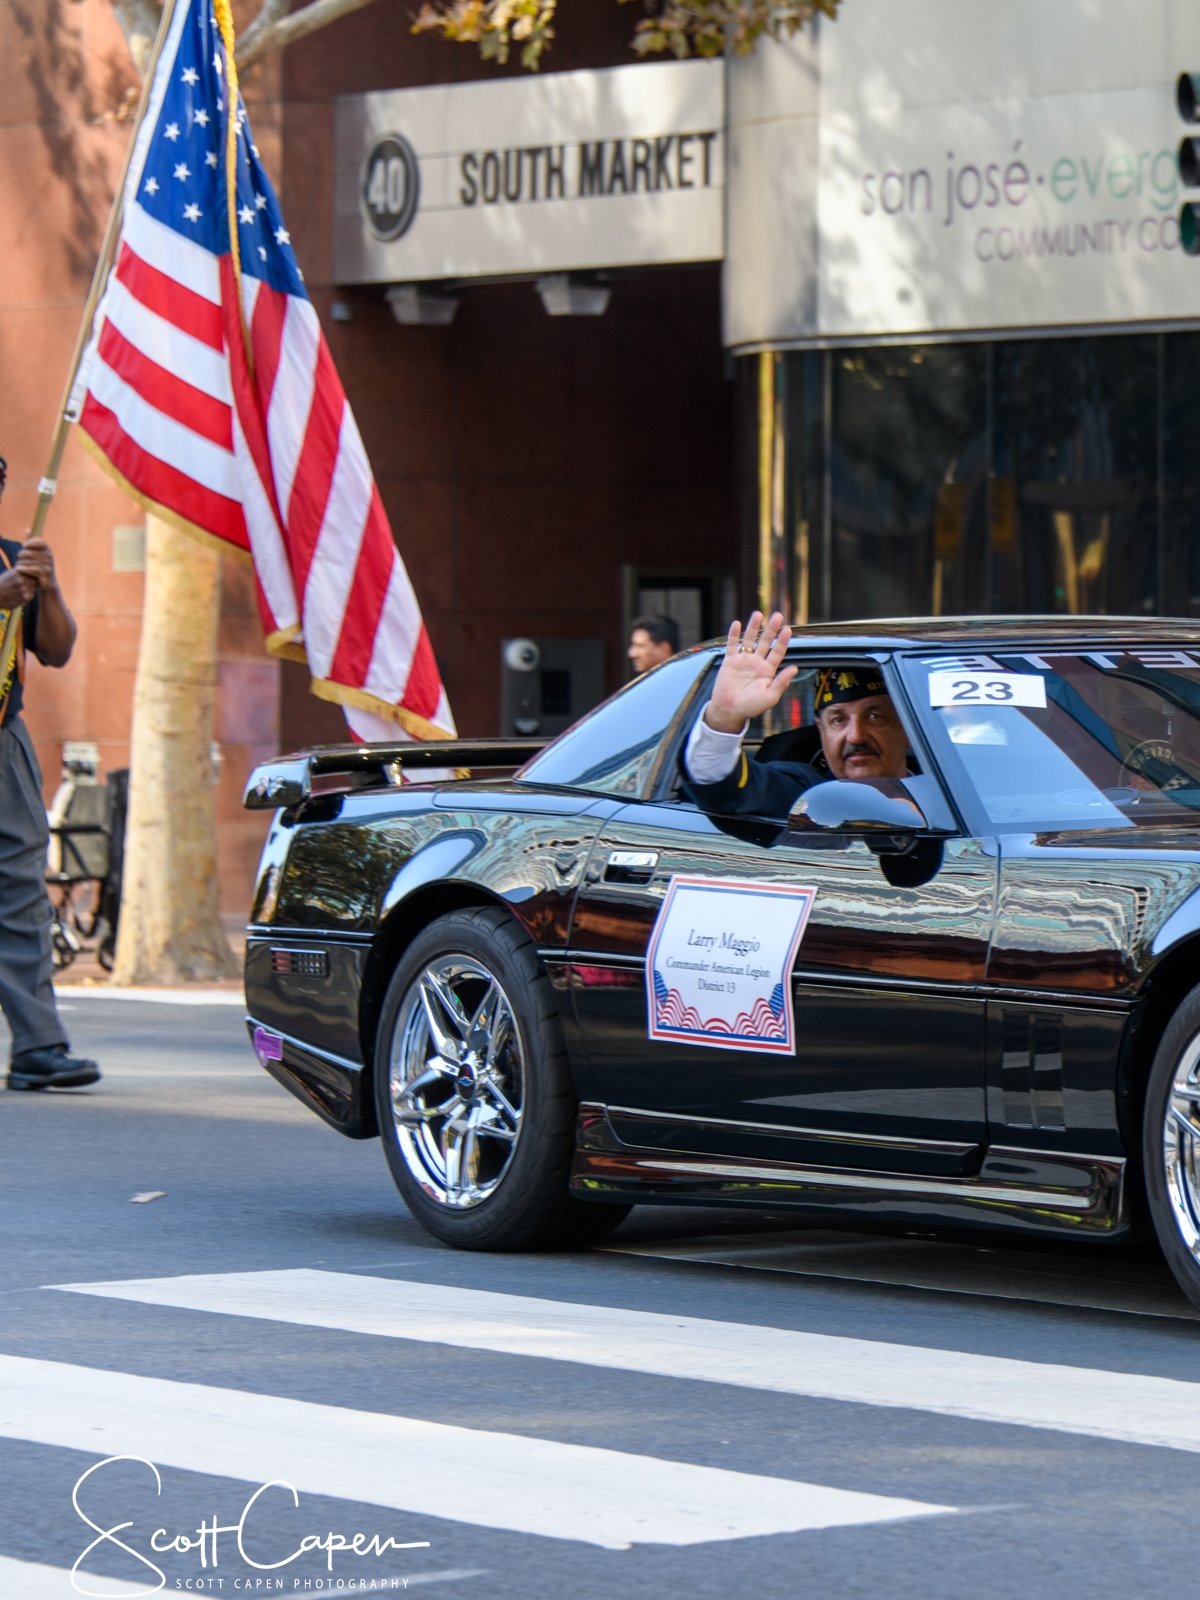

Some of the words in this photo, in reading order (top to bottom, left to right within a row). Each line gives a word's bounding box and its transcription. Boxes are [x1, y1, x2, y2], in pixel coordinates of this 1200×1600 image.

[367, 157, 404, 216] 40
[460, 145, 566, 206] SOUTH
[579, 132, 718, 196] MARKET
[861, 169, 933, 216] san
[975, 216, 1132, 263] COMMUNITY
[951, 680, 1014, 701] 23
[687, 929, 718, 953] Larry
[718, 932, 761, 957] Maggio
[666, 956, 710, 971] Commander
[710, 961, 744, 976] American
[746, 964, 771, 981] Legion
[698, 978, 725, 992] District
[726, 981, 736, 994] 13
